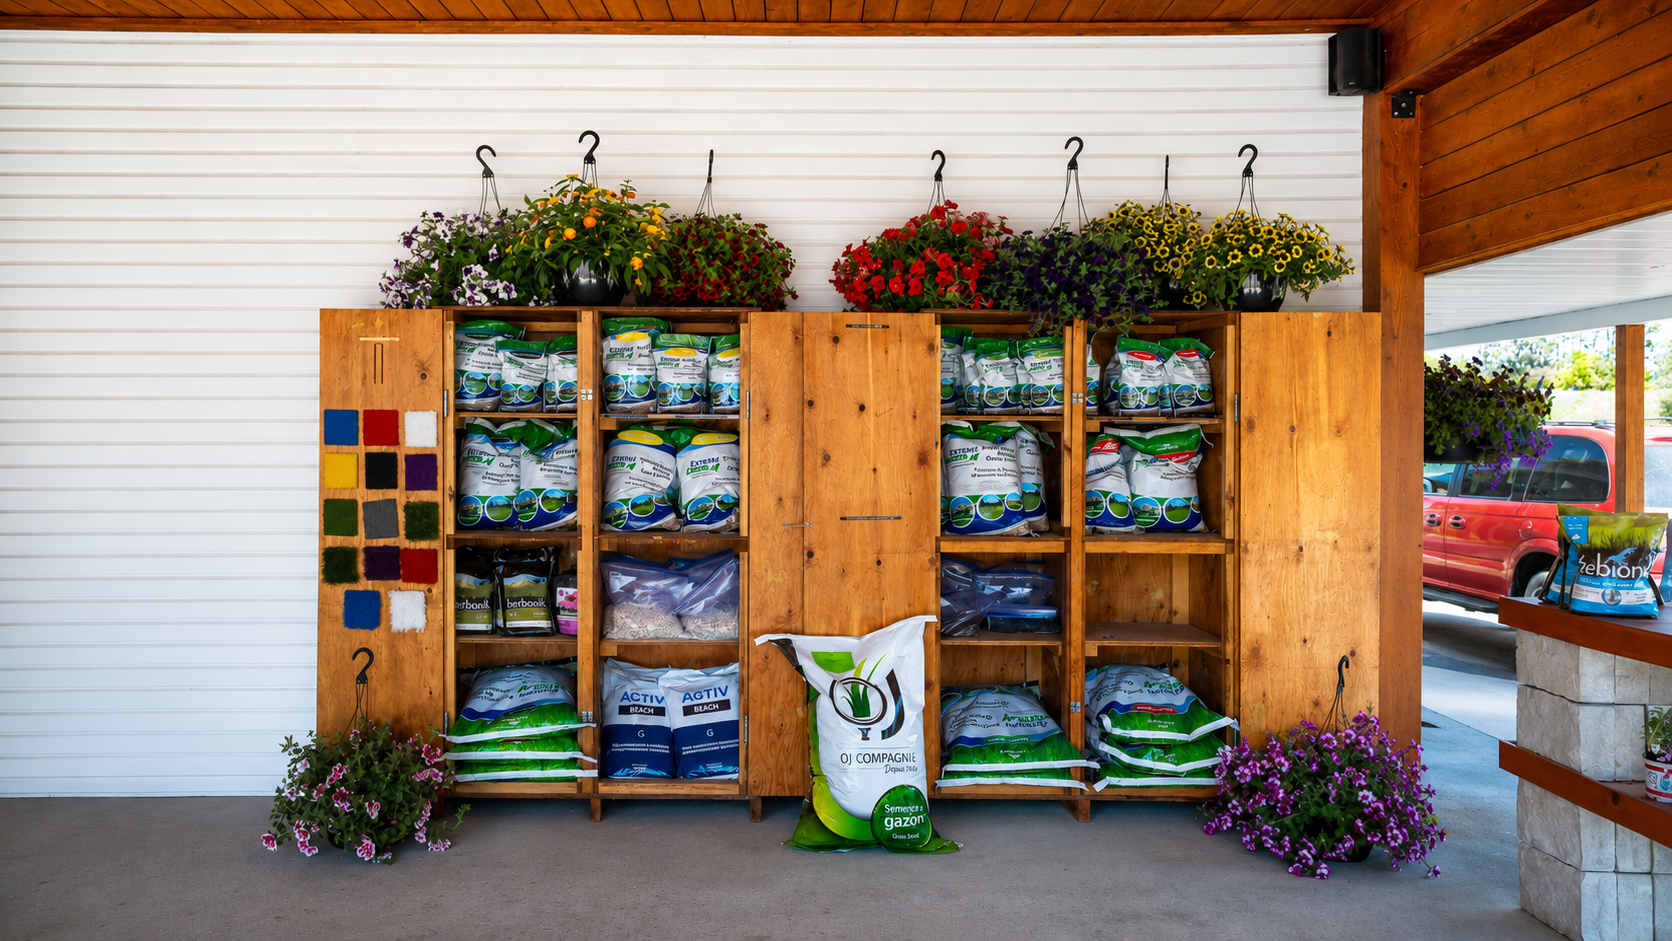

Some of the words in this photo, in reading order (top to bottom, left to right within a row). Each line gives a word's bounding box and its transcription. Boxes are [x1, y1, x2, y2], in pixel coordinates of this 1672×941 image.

[620, 690, 664, 705] ACTIV
[637, 729, 645, 738] G
[706, 728, 714, 737] G
[840, 752, 852, 766] OJ
[855, 752, 917, 764] COMPAGNIE
[884, 815, 925, 831] gazon
